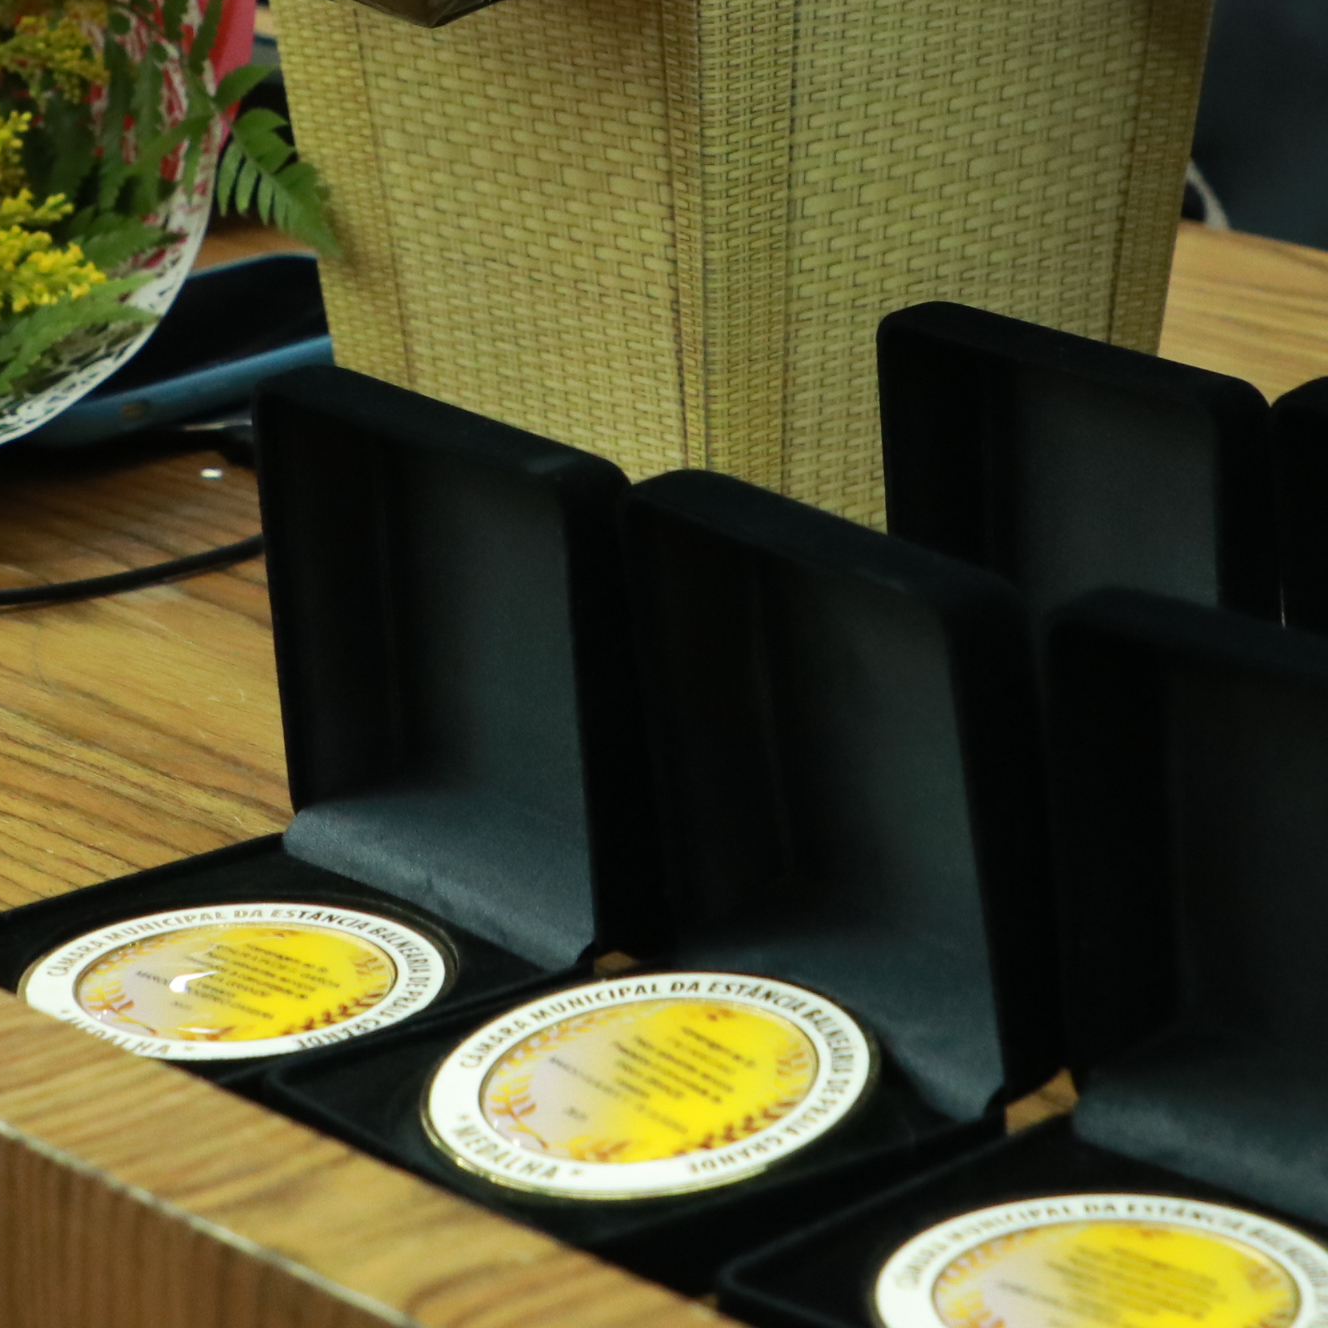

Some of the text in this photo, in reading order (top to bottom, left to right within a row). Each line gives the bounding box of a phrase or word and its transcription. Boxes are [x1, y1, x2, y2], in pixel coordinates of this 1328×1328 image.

[104, 911, 227, 942] MUNICIPAL
[234, 909, 263, 918] DA
[271, 908, 368, 930] ESTÂNCIA
[530, 983, 662, 1021] MUNICIPAL
[671, 981, 700, 992] DA
[708, 981, 807, 1013] ESTÂNCIA
